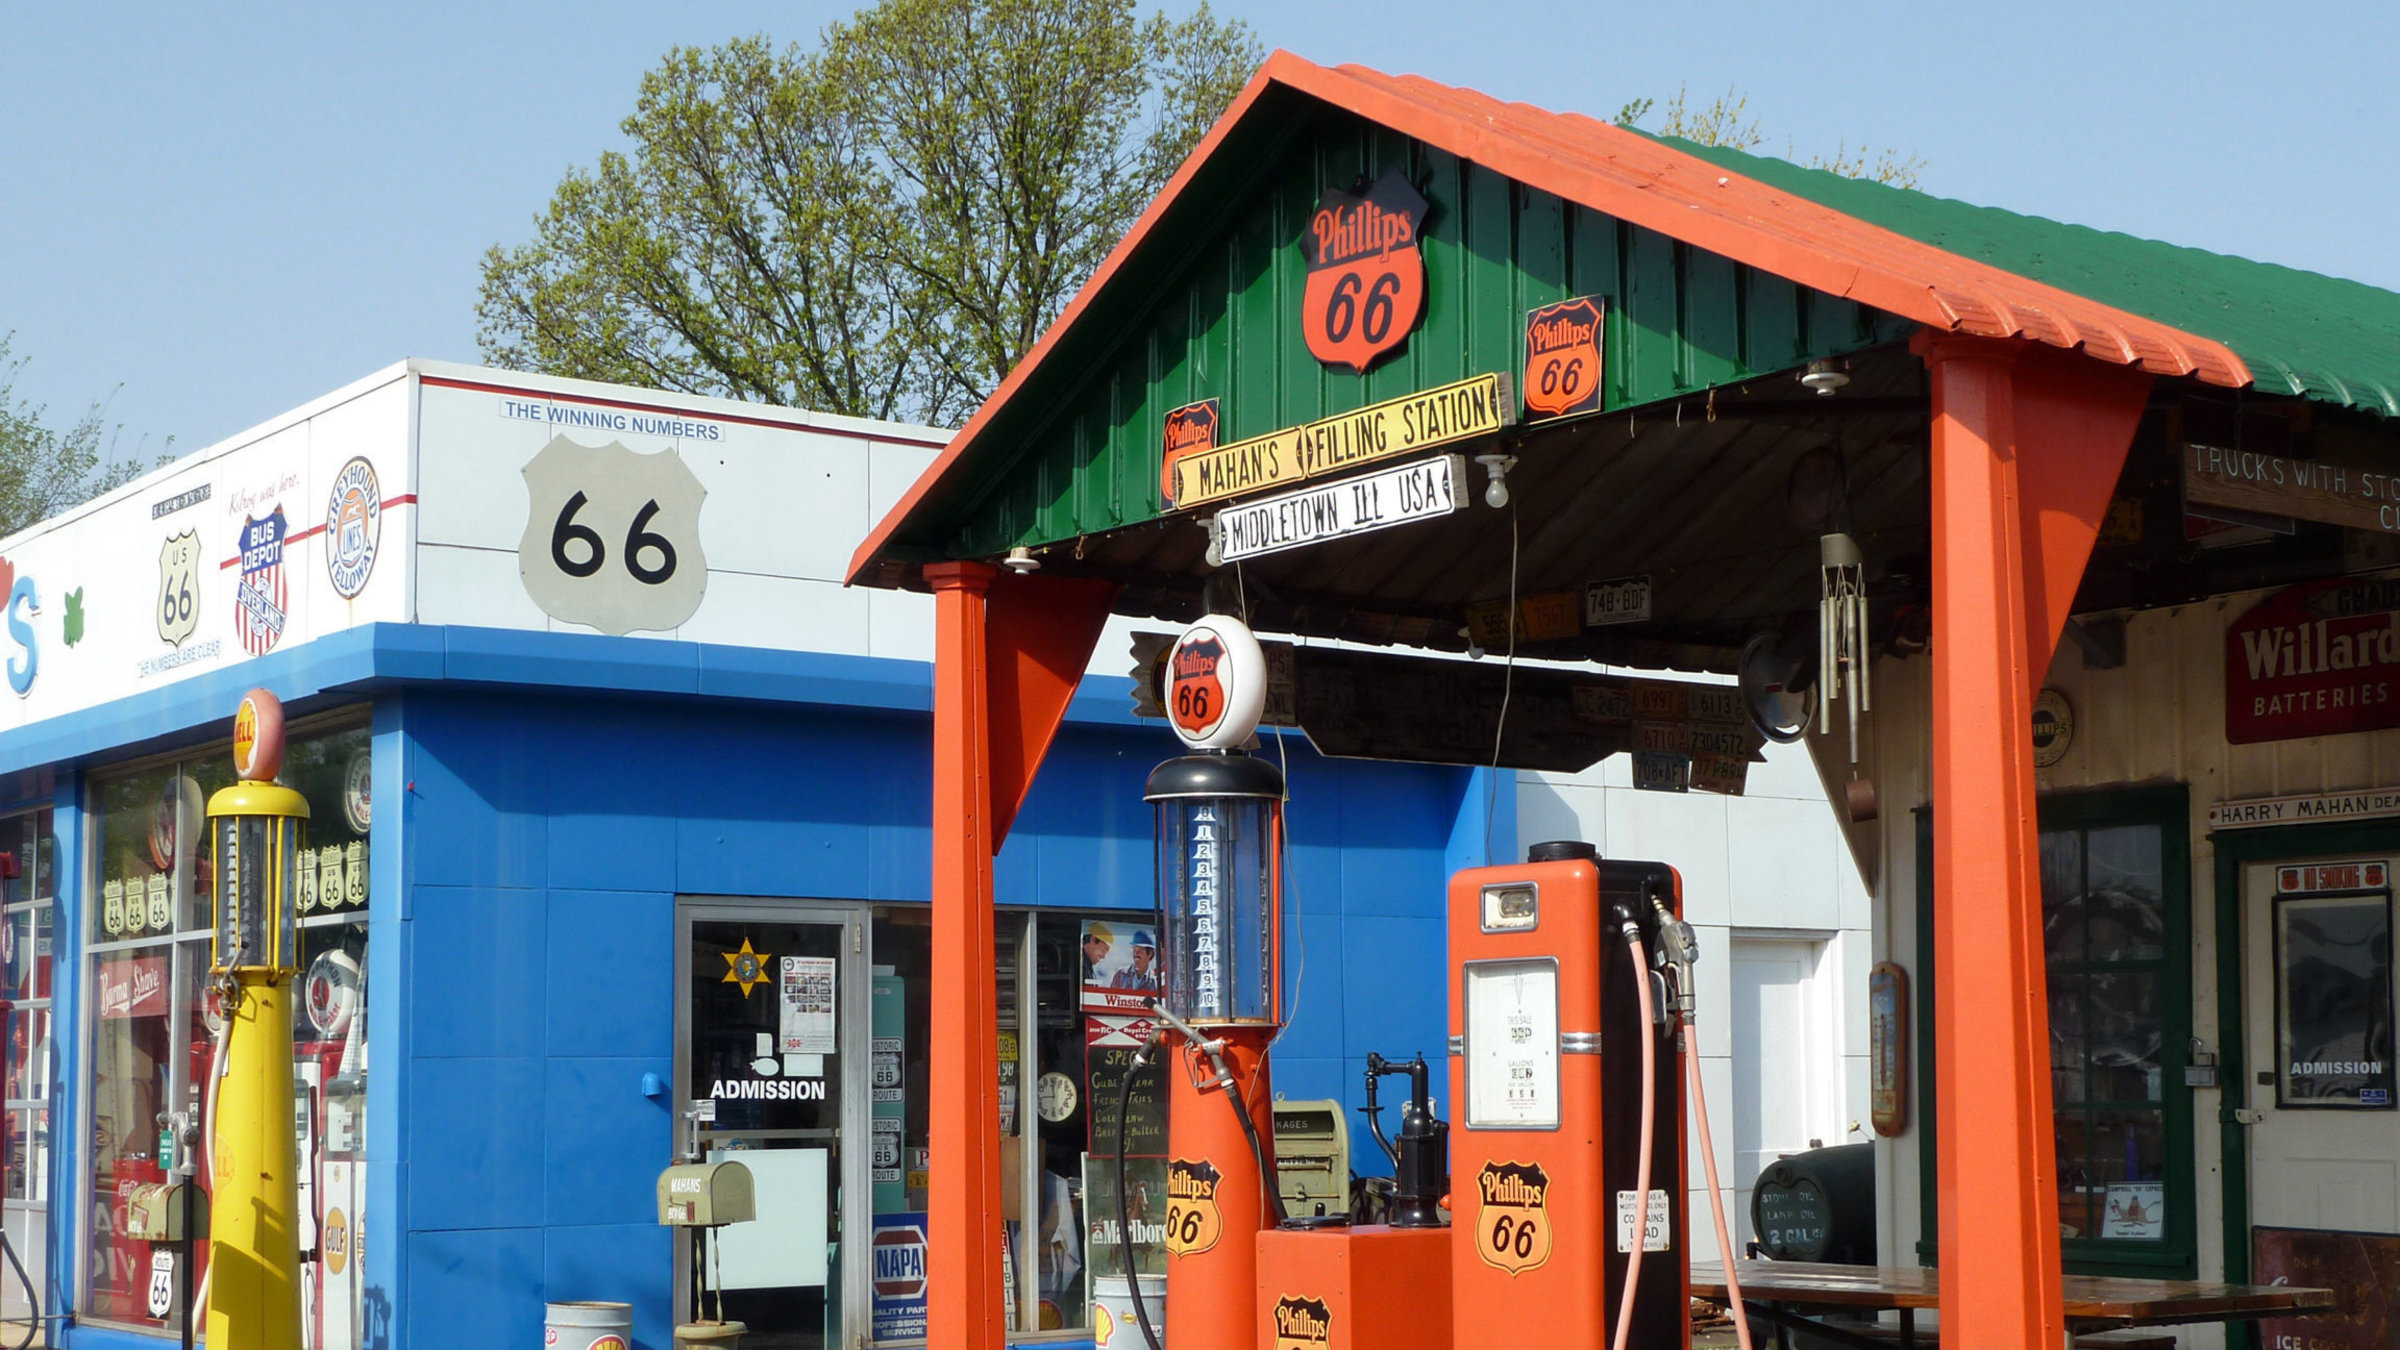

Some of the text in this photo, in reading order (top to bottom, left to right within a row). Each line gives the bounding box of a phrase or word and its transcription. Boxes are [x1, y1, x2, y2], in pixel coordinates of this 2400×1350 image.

[1313, 201, 1412, 264] Phillips
[1325, 271, 1401, 344] 66
[1533, 317, 1591, 352] Phillips
[1541, 358, 1583, 396] 66
[505, 401, 719, 440] THE WINNING NUMBERS
[1168, 419, 1209, 449] Phillips
[1200, 384, 1487, 497] MAHAN'S FILLING STATION
[2189, 443, 2285, 486] TRUCKS
[2292, 459, 2347, 494] WITH
[328, 464, 378, 535] GREYHOUND
[1231, 468, 1438, 553] MIDDLETOWN ILL USA
[250, 521, 275, 547] BUS
[342, 524, 362, 555] LINES
[551, 489, 677, 585] 66
[243, 541, 281, 571] DEPOT
[331, 536, 374, 591] YELLOWAY
[164, 570, 192, 626] 66
[2240, 610, 2400, 681] Willard
[1174, 649, 1215, 678] Phillips
[1178, 684, 1209, 719] 66
[2253, 682, 2389, 717] BATTERIES
[2221, 803, 2284, 823] HARRY
[2297, 796, 2369, 817] MAHAN
[325, 879, 340, 901] 66
[350, 876, 364, 897] 66
[2304, 865, 2360, 890] NO SMOKING
[109, 909, 121, 929] 66
[129, 907, 142, 926] 66
[152, 903, 166, 923] 66
[100, 964, 160, 1017] Burma Shave
[1105, 994, 1149, 1009] Winsto
[872, 1040, 899, 1051] ISTORIC
[877, 1071, 893, 1082] 66
[2290, 1060, 2382, 1075] ADMISSION
[710, 1079, 826, 1100] ADMISSION
[872, 1120, 899, 1131] ISTORIC
[1276, 1119, 1309, 1129] KAGES
[874, 1151, 891, 1162] 66
[670, 1178, 701, 1193] MAHANS
[1483, 1171, 1542, 1212] Phillips
[1167, 1205, 1203, 1245] 66
[1623, 1213, 1665, 1224] COAINS
[1630, 1226, 1659, 1239] LAD
[325, 1226, 345, 1255] GULF
[1492, 1214, 1536, 1259] 66
[1770, 1229, 1782, 1245] 2
[876, 1248, 922, 1278] NAPA
[152, 1275, 168, 1306] 66
[882, 1326, 924, 1337] SERVICE
[1278, 1305, 1326, 1344] Phillips
[2276, 1335, 2302, 1350] ICE
